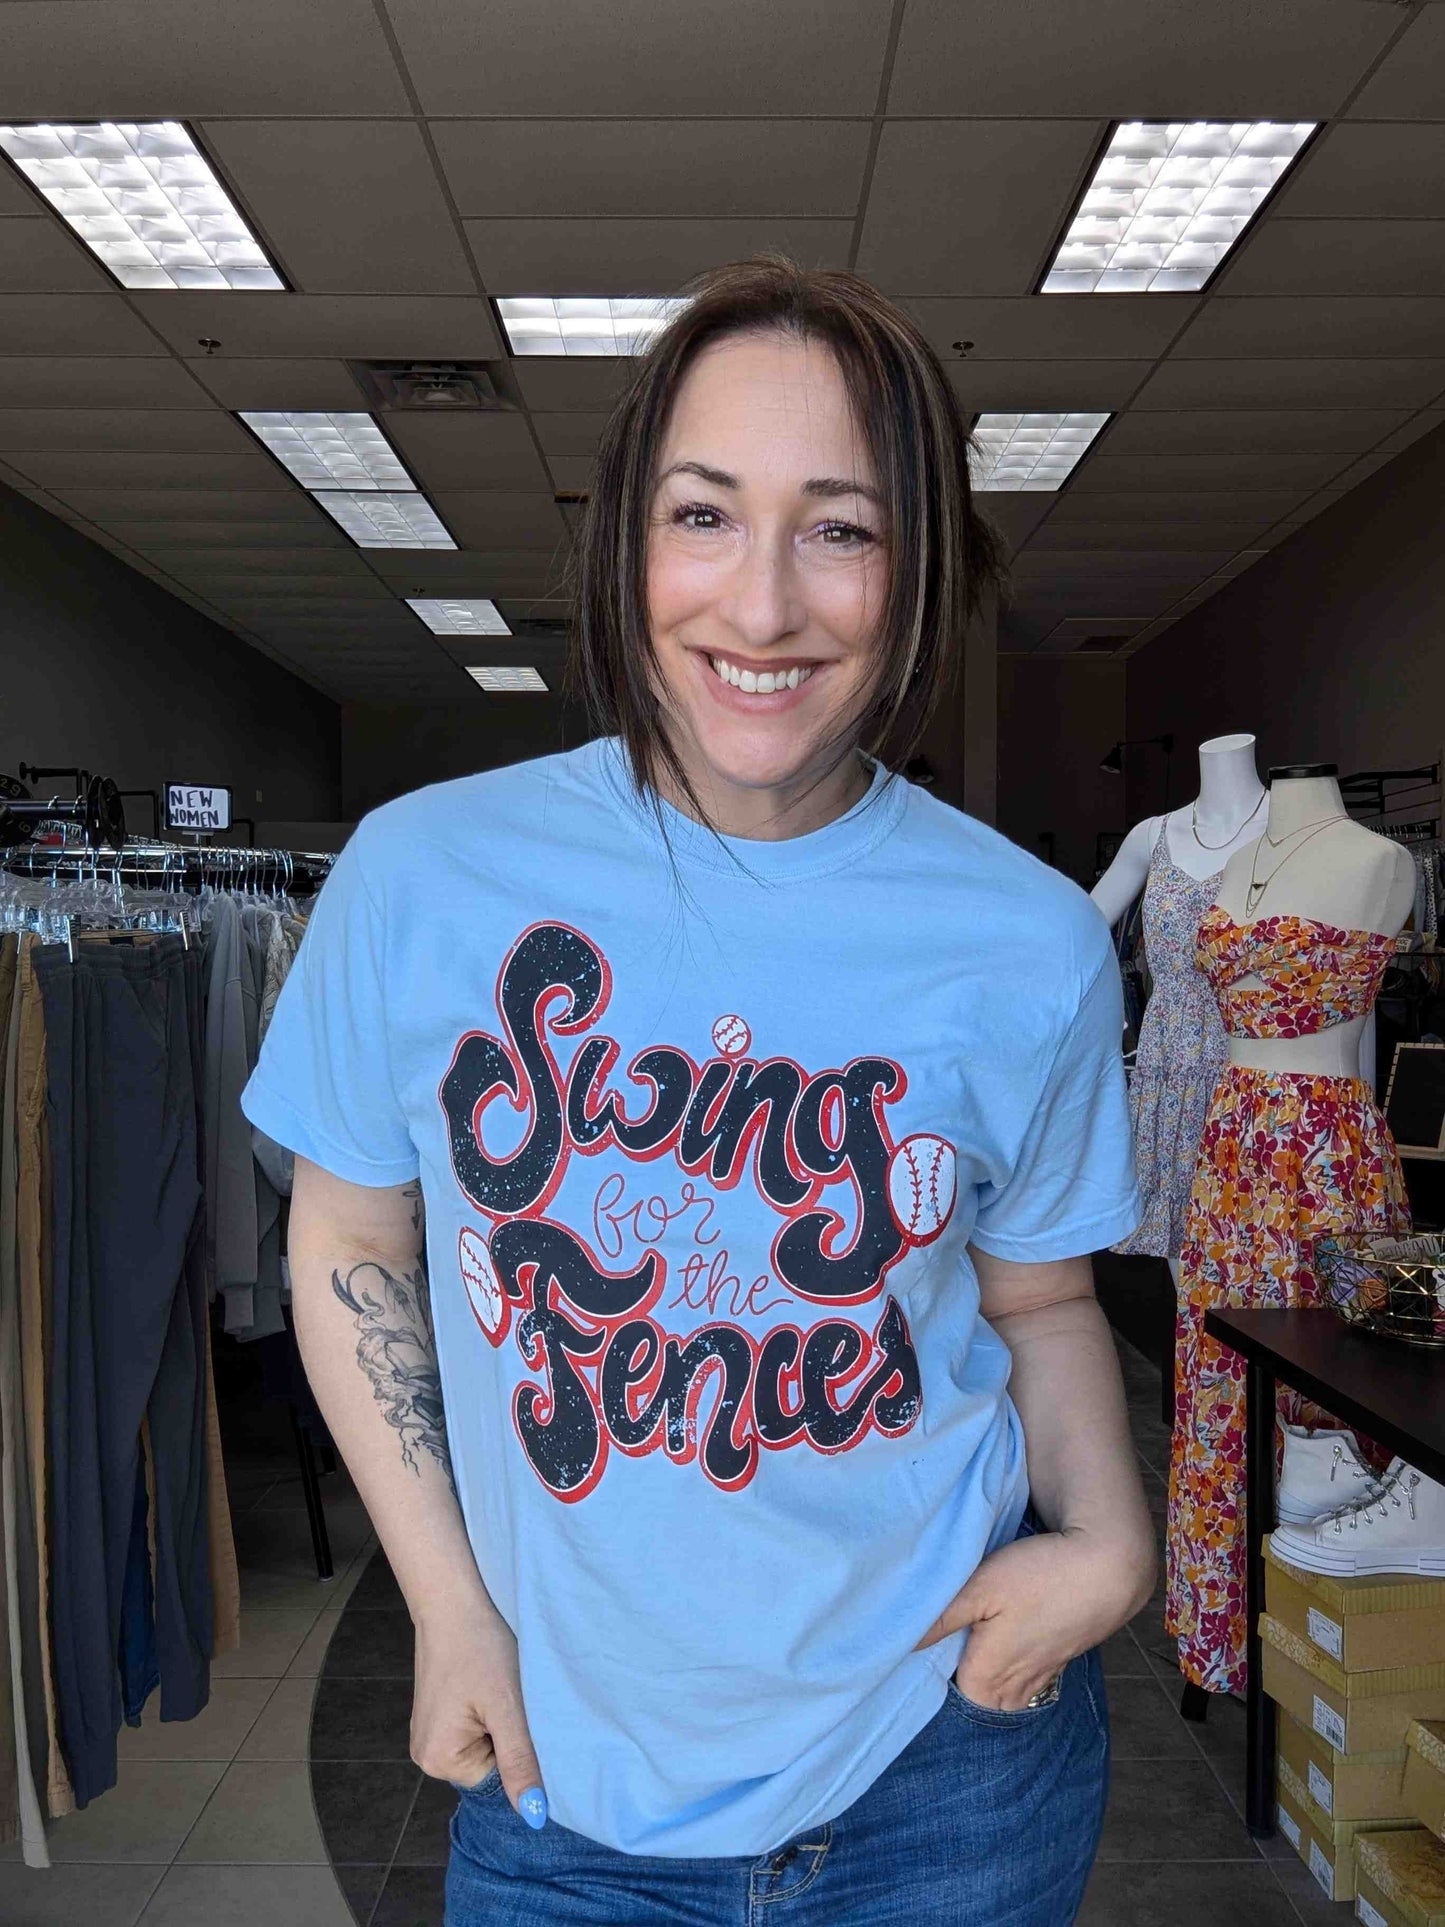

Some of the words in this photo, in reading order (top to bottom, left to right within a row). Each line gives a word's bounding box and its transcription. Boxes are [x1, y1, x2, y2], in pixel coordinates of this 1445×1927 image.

[170, 789, 213, 808] NEW
[170, 808, 219, 827] WOMEN
[439, 920, 908, 1307] Swing
[594, 1173, 722, 1258] for
[668, 1252, 794, 1316] the
[488, 1217, 923, 1504] Fences
